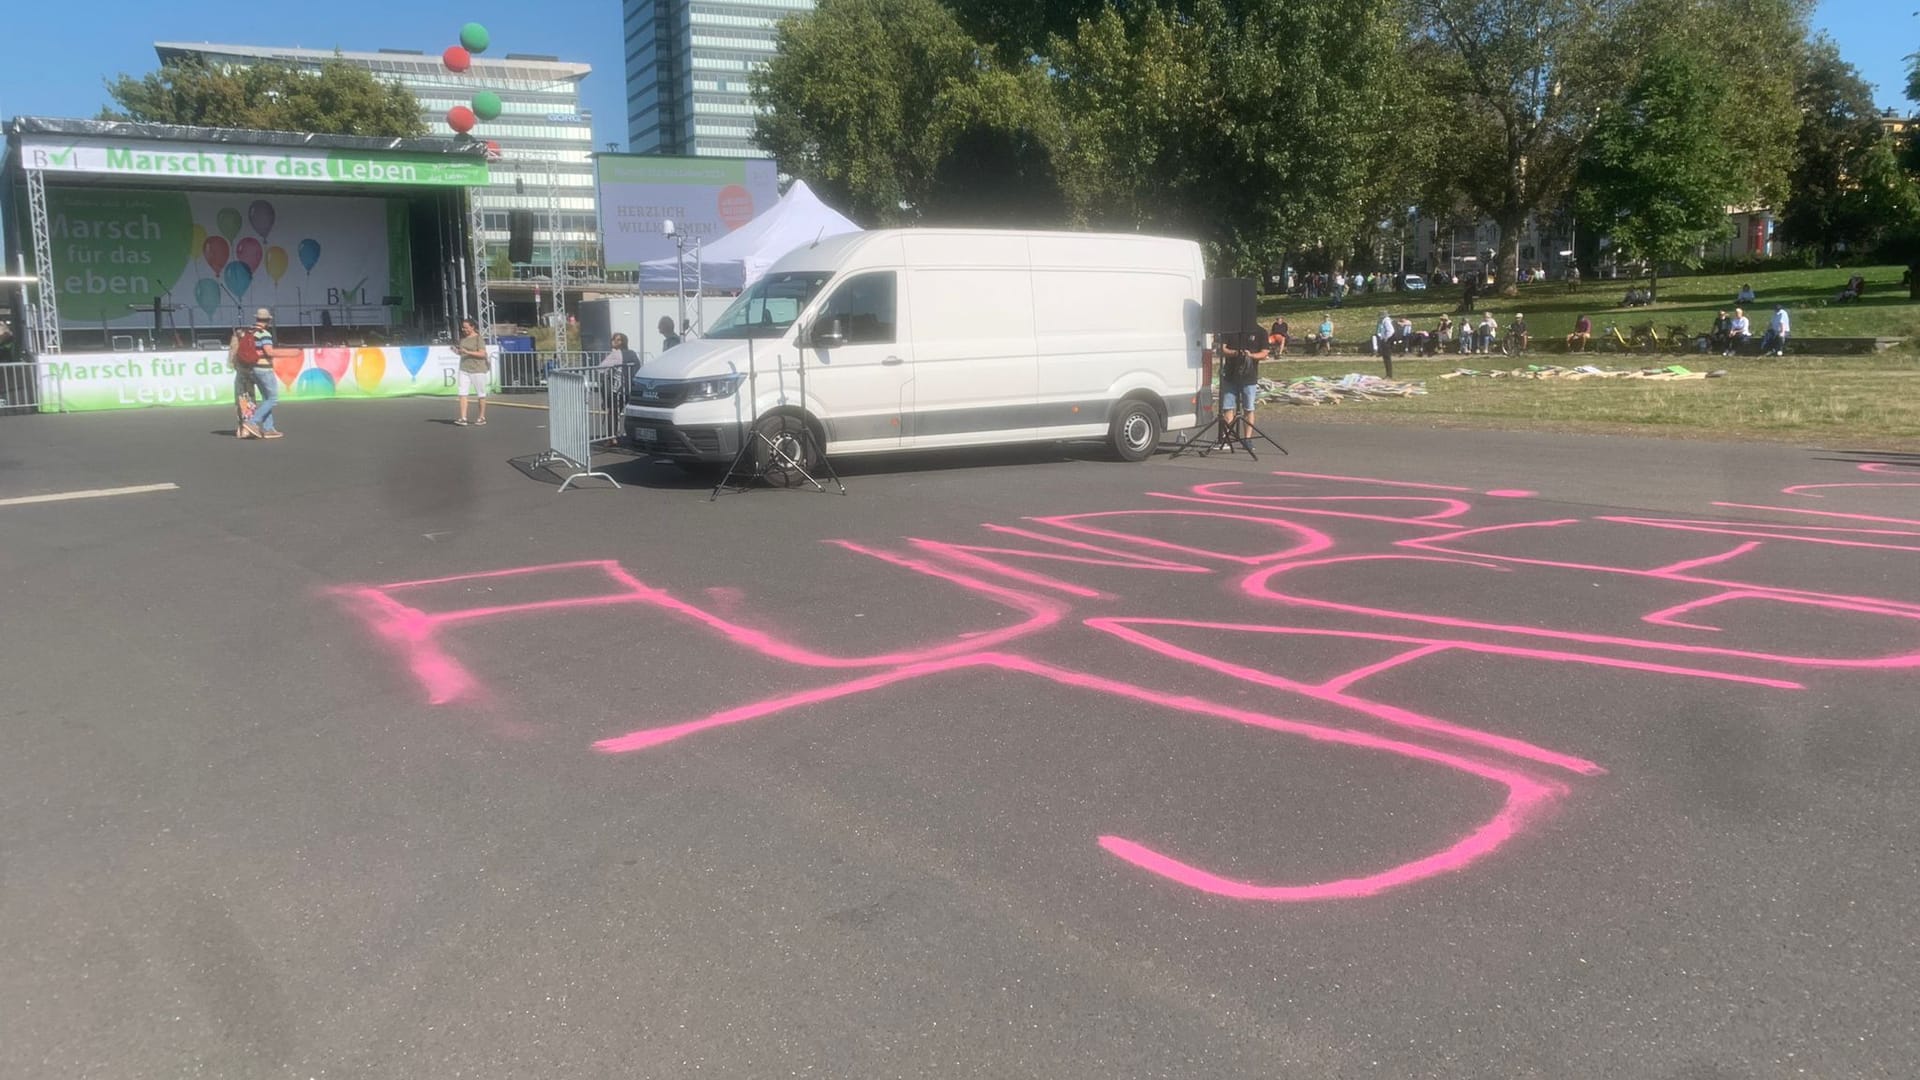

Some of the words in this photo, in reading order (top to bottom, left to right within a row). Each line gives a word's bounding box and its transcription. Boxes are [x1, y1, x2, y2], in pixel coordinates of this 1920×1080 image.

[106, 147, 217, 173] Marsch
[225, 152, 266, 177] für
[275, 155, 322, 179] das
[338, 158, 417, 181] Leben
[617, 205, 685, 217] HERZLICH
[617, 221, 718, 234] WILLKMMEN!
[67, 244, 101, 264] für
[111, 246, 152, 264] das
[50, 359, 142, 380] Marsch
[152, 358, 186, 377] für
[119, 383, 217, 404] Leben
